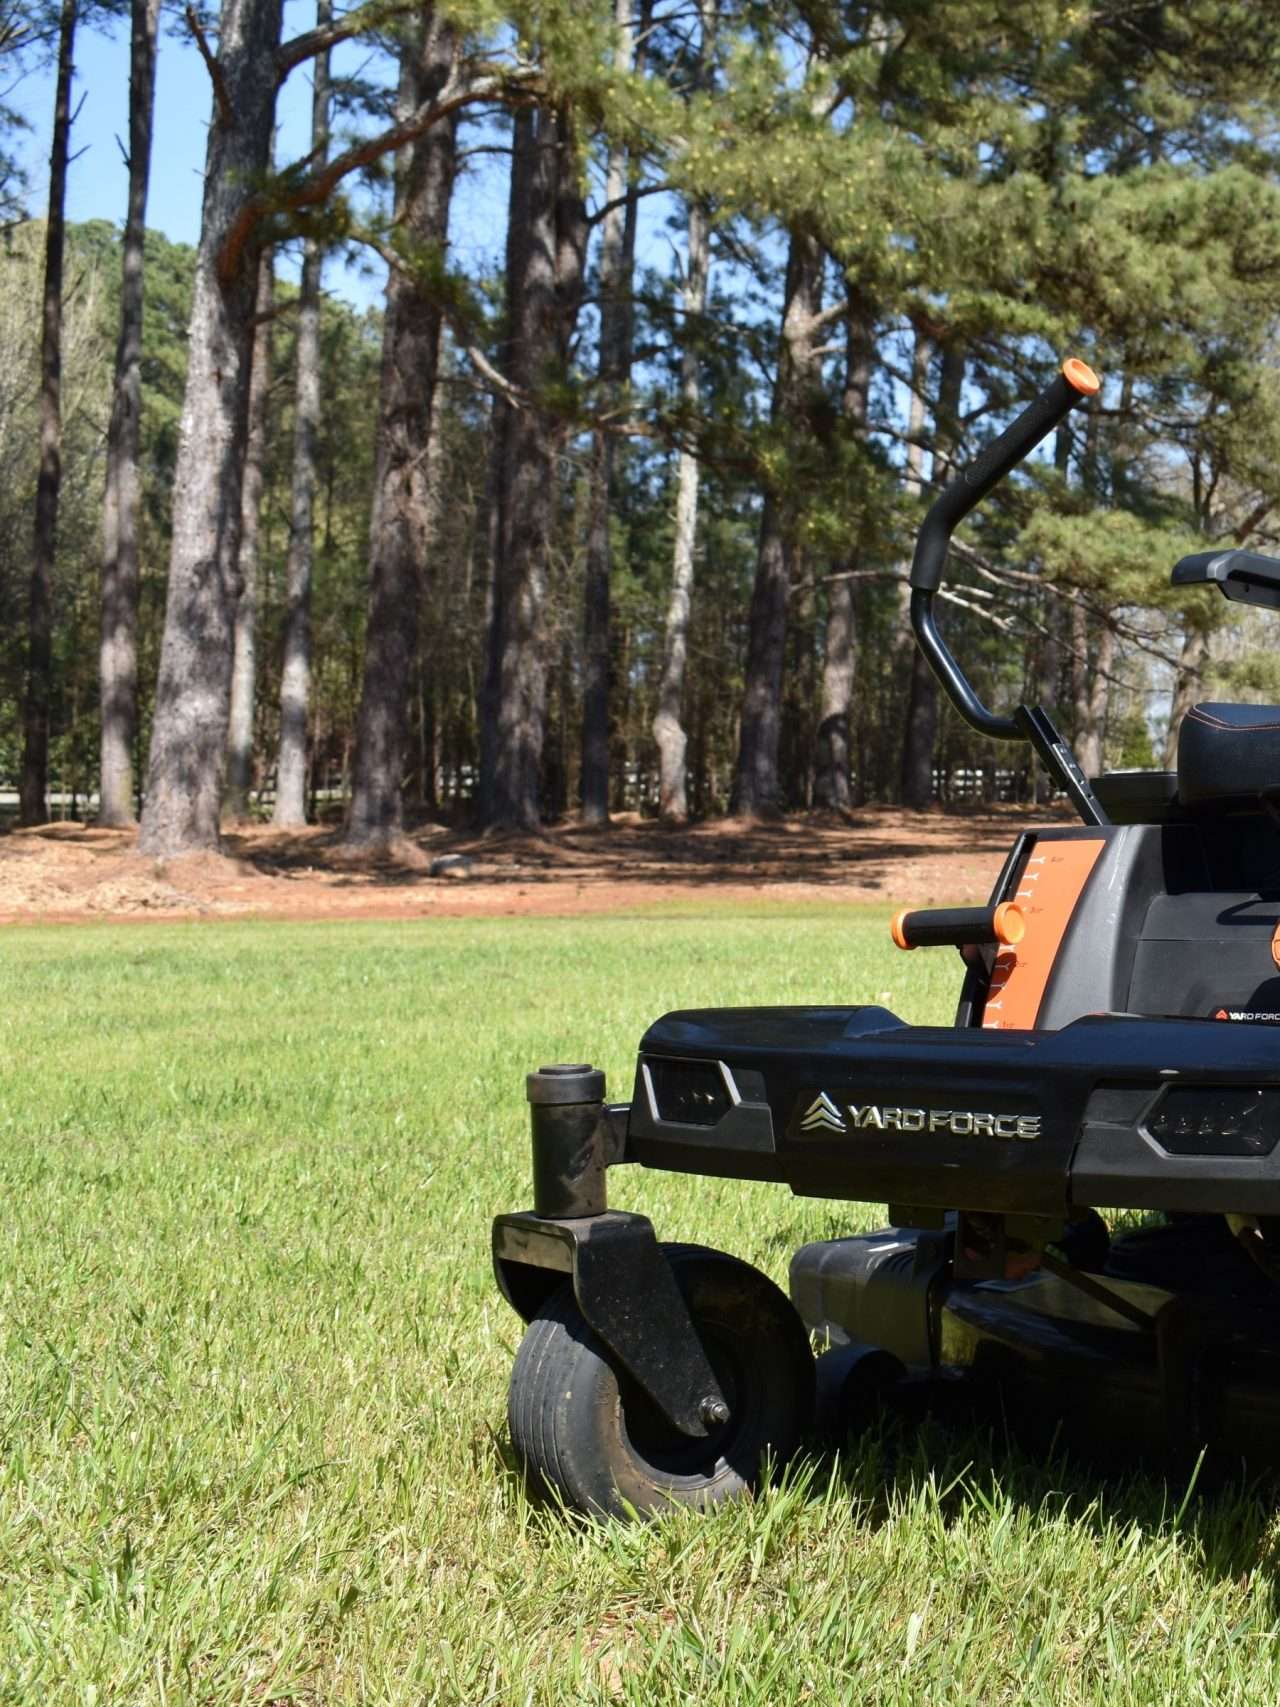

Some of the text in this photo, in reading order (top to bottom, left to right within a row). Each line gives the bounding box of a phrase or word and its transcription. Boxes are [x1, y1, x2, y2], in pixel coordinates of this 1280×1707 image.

[1229, 1011, 1254, 1021] YARD
[848, 1105, 1042, 1139] YARD FORCE
